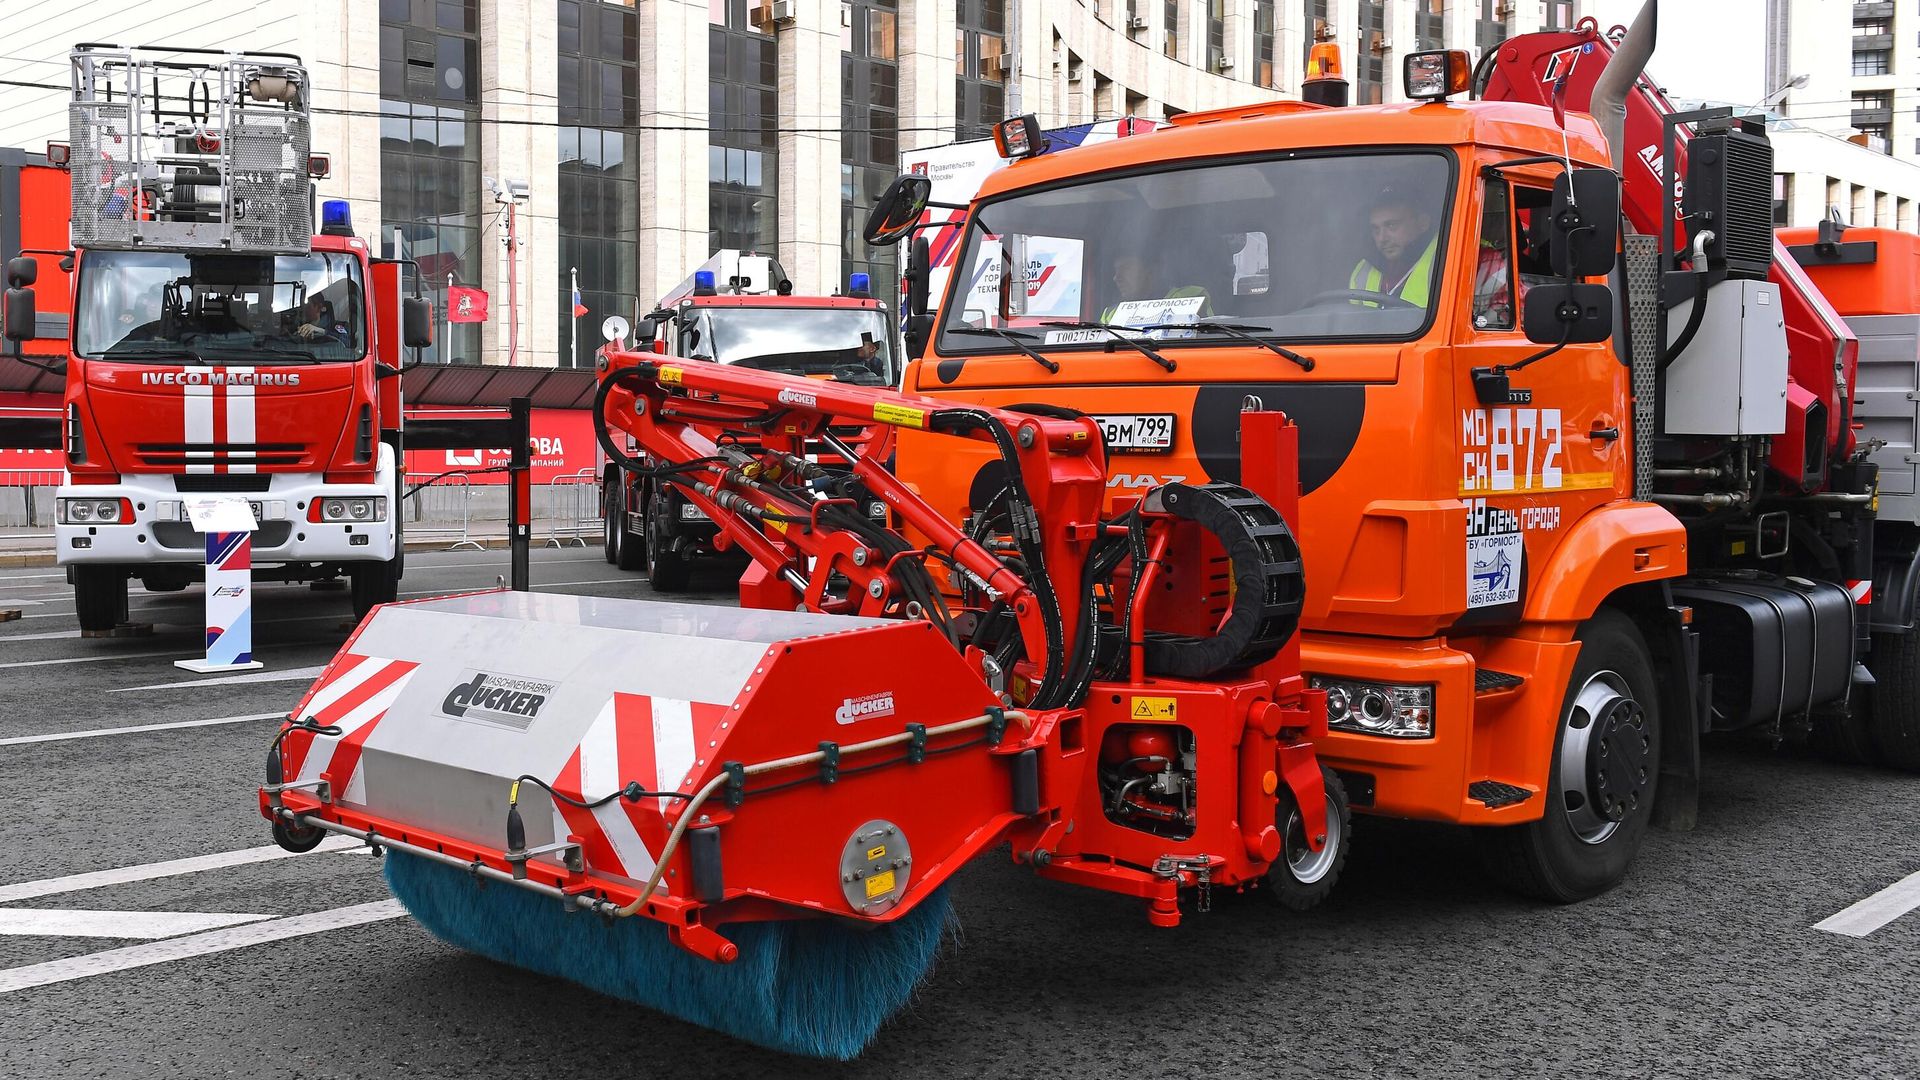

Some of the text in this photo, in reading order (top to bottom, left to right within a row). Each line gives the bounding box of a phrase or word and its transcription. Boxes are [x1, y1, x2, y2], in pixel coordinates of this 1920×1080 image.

[930, 160, 975, 172] Правительство
[1027, 281, 1041, 290] 019
[142, 372, 300, 385] IVECO MAGIRUS
[1137, 417, 1167, 437] 799
[1142, 436, 1157, 444] RUS
[1491, 408, 1562, 491] 872
[1488, 506, 1561, 536] ДЕНЬ ГОРОДА
[1467, 539, 1480, 550] БУ
[1468, 594, 1485, 608] (495)
[484, 675, 555, 694] MASCHINENFABRIK
